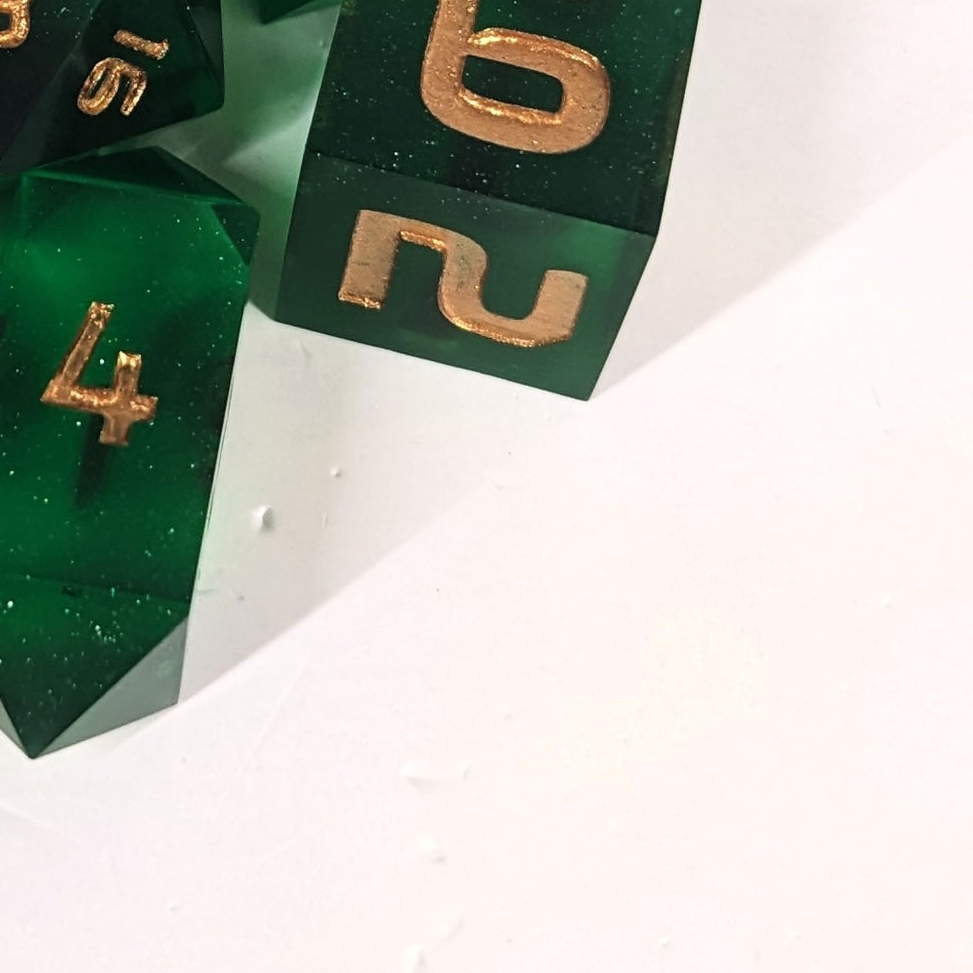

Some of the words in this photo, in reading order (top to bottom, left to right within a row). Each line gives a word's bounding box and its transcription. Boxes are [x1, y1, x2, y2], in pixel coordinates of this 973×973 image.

[76, 29, 170, 116] 16
[337, 209, 589, 348] 2
[40, 301, 158, 446] 4
